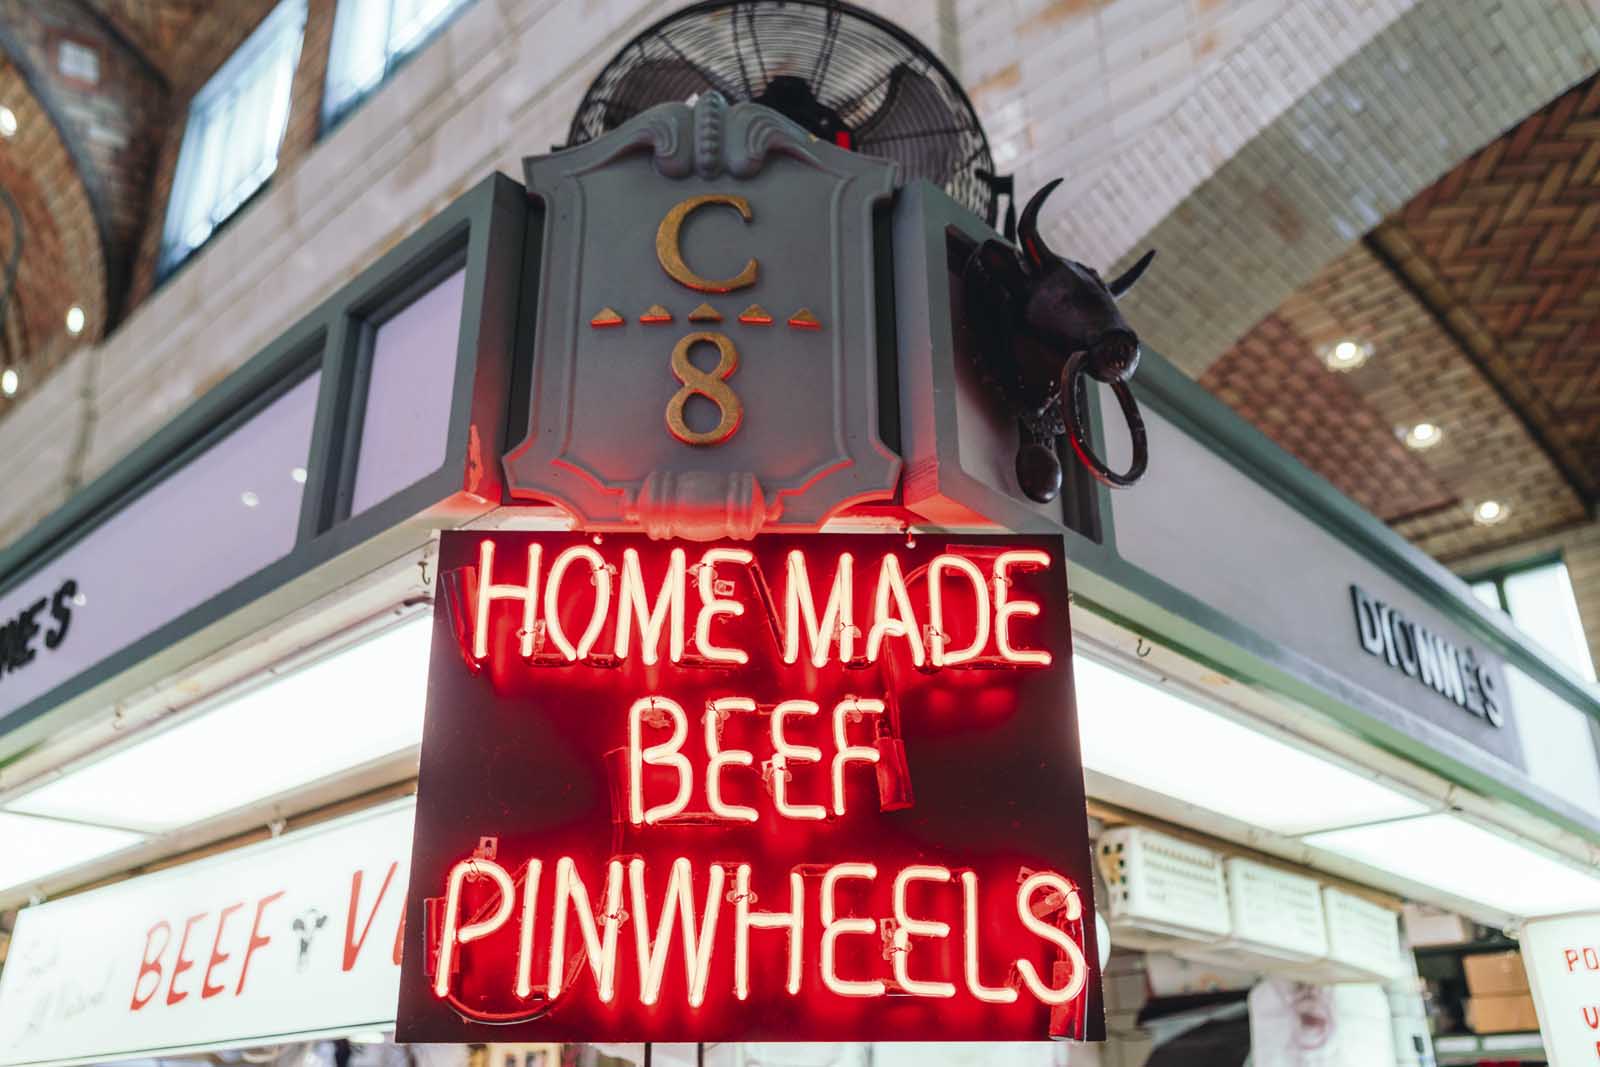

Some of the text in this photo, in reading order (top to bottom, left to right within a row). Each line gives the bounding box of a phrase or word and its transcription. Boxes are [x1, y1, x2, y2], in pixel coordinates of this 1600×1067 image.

[656, 193, 759, 293] C
[665, 331, 744, 446] 8
[475, 539, 1052, 669] HOME MADE
[627, 696, 886, 825] BEEF
[129, 889, 287, 1011] BEEF
[342, 861, 409, 972] V
[434, 856, 1087, 1008] PINWHEELS
